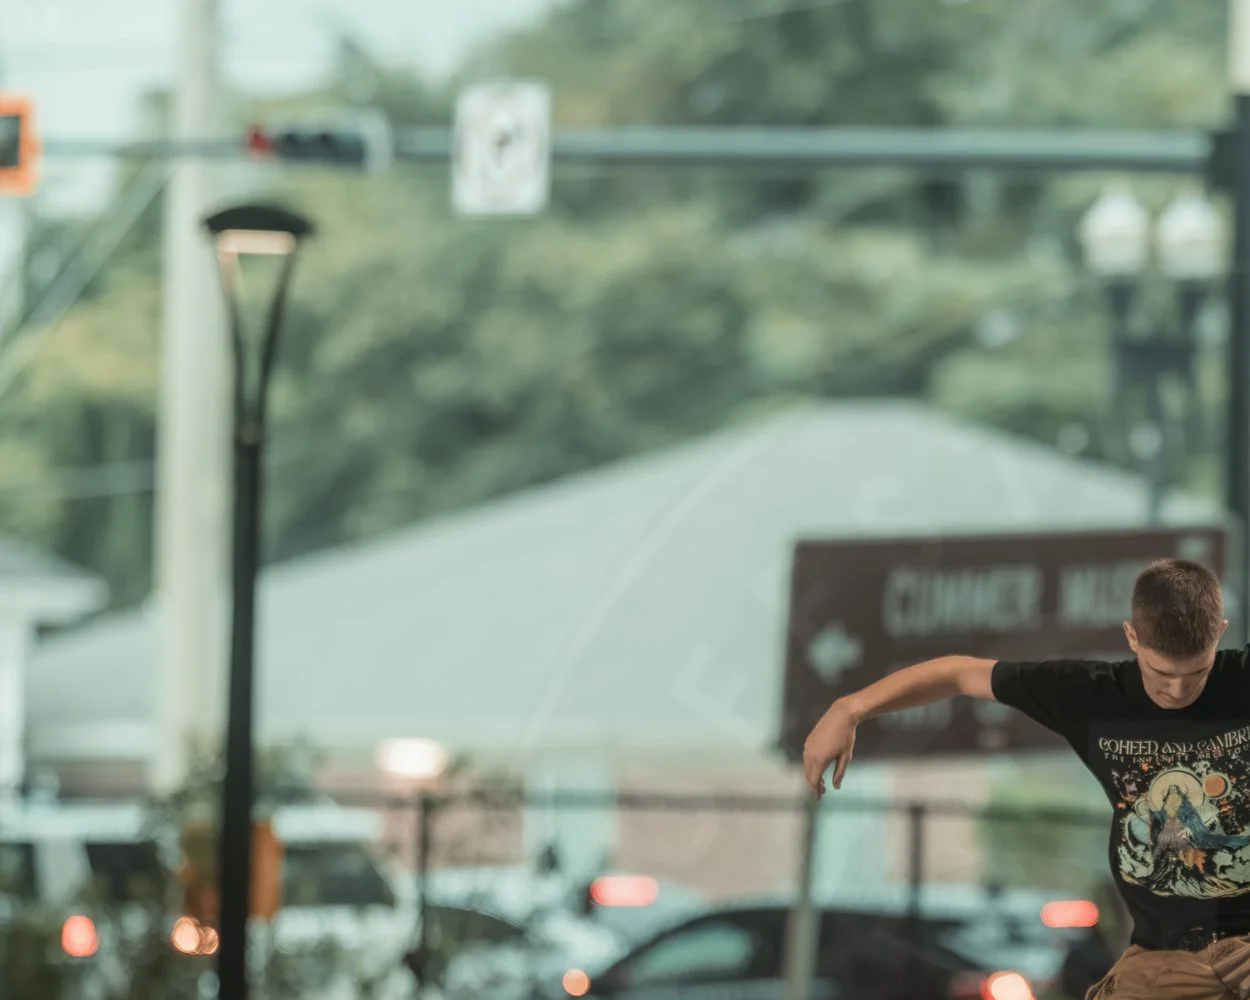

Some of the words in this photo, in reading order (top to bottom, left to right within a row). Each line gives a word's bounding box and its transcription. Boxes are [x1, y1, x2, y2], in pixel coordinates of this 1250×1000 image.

[1099, 737, 1159, 755] COHEED
[1162, 741, 1194, 753] AND
[1103, 751, 1125, 763] THE
